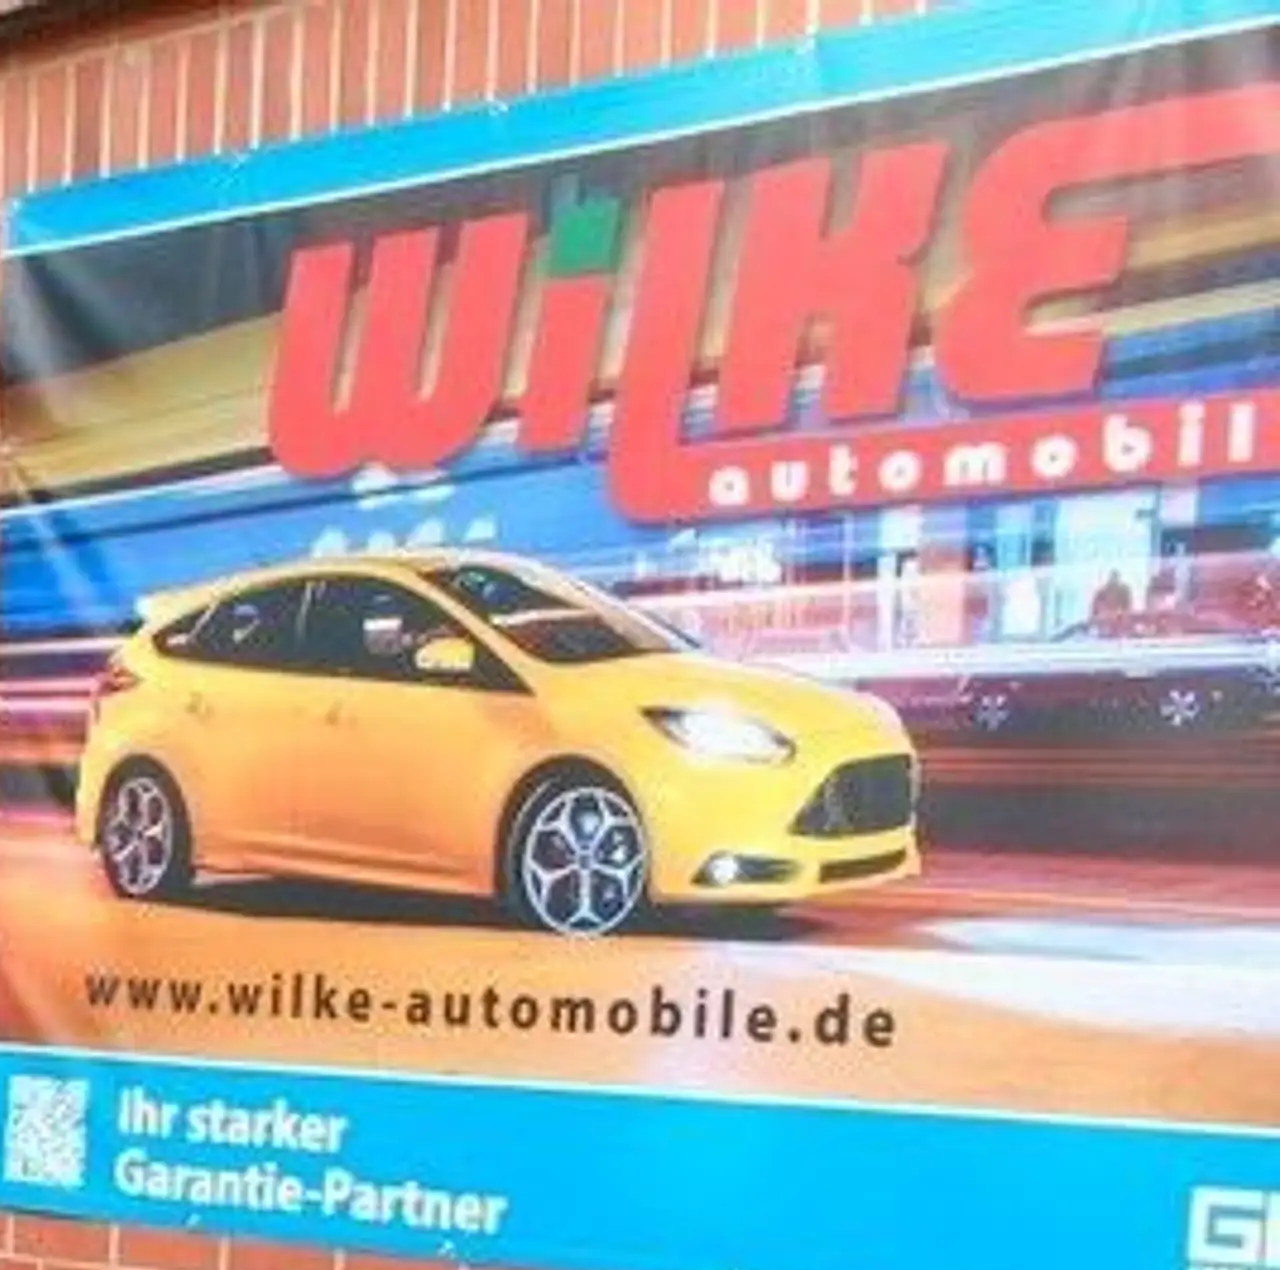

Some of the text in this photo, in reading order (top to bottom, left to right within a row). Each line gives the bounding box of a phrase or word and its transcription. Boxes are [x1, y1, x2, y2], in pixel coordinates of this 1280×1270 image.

[84, 972, 897, 1047] www.wilke-automobile.de
[118, 1085, 350, 1154] Ihr starker
[113, 1146, 509, 1234] Garantie-Partner
